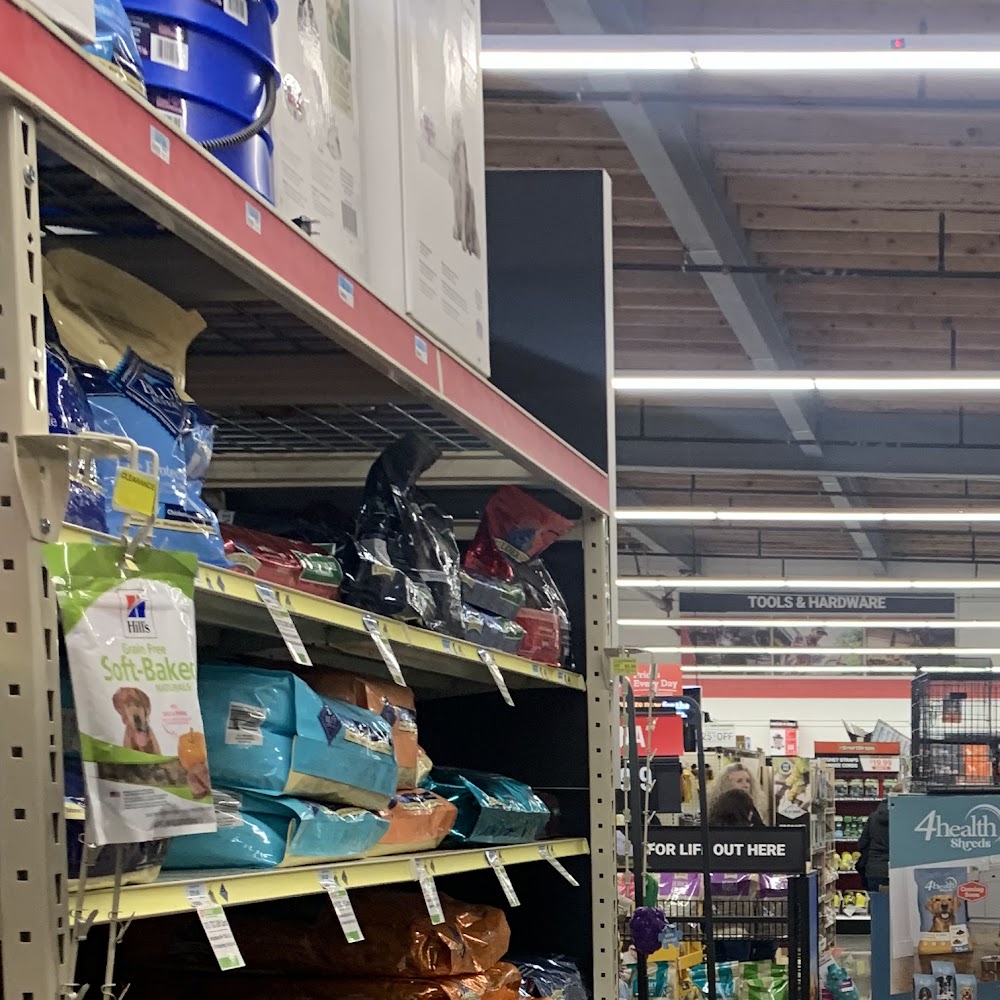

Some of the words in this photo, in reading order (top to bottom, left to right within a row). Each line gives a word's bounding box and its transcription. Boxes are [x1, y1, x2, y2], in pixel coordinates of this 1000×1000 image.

[120, 472, 156, 491] CLEARANCE
[747, 595, 794, 609] TOOLS
[796, 595, 806, 609] &
[808, 595, 887, 609] HARDWARE
[127, 620, 151, 633] Hill's
[121, 642, 145, 655] Grain
[147, 643, 167, 655] Free
[155, 683, 192, 692] NATURALS
[633, 679, 659, 691] Evey
[660, 679, 678, 689] Day
[717, 731, 734, 741] OFF
[647, 843, 676, 856] FOR
[680, 843, 703, 856] LIF
[713, 843, 744, 857] OUT
[748, 843, 786, 857] HERE
[950, 838, 992, 851] Shreds
